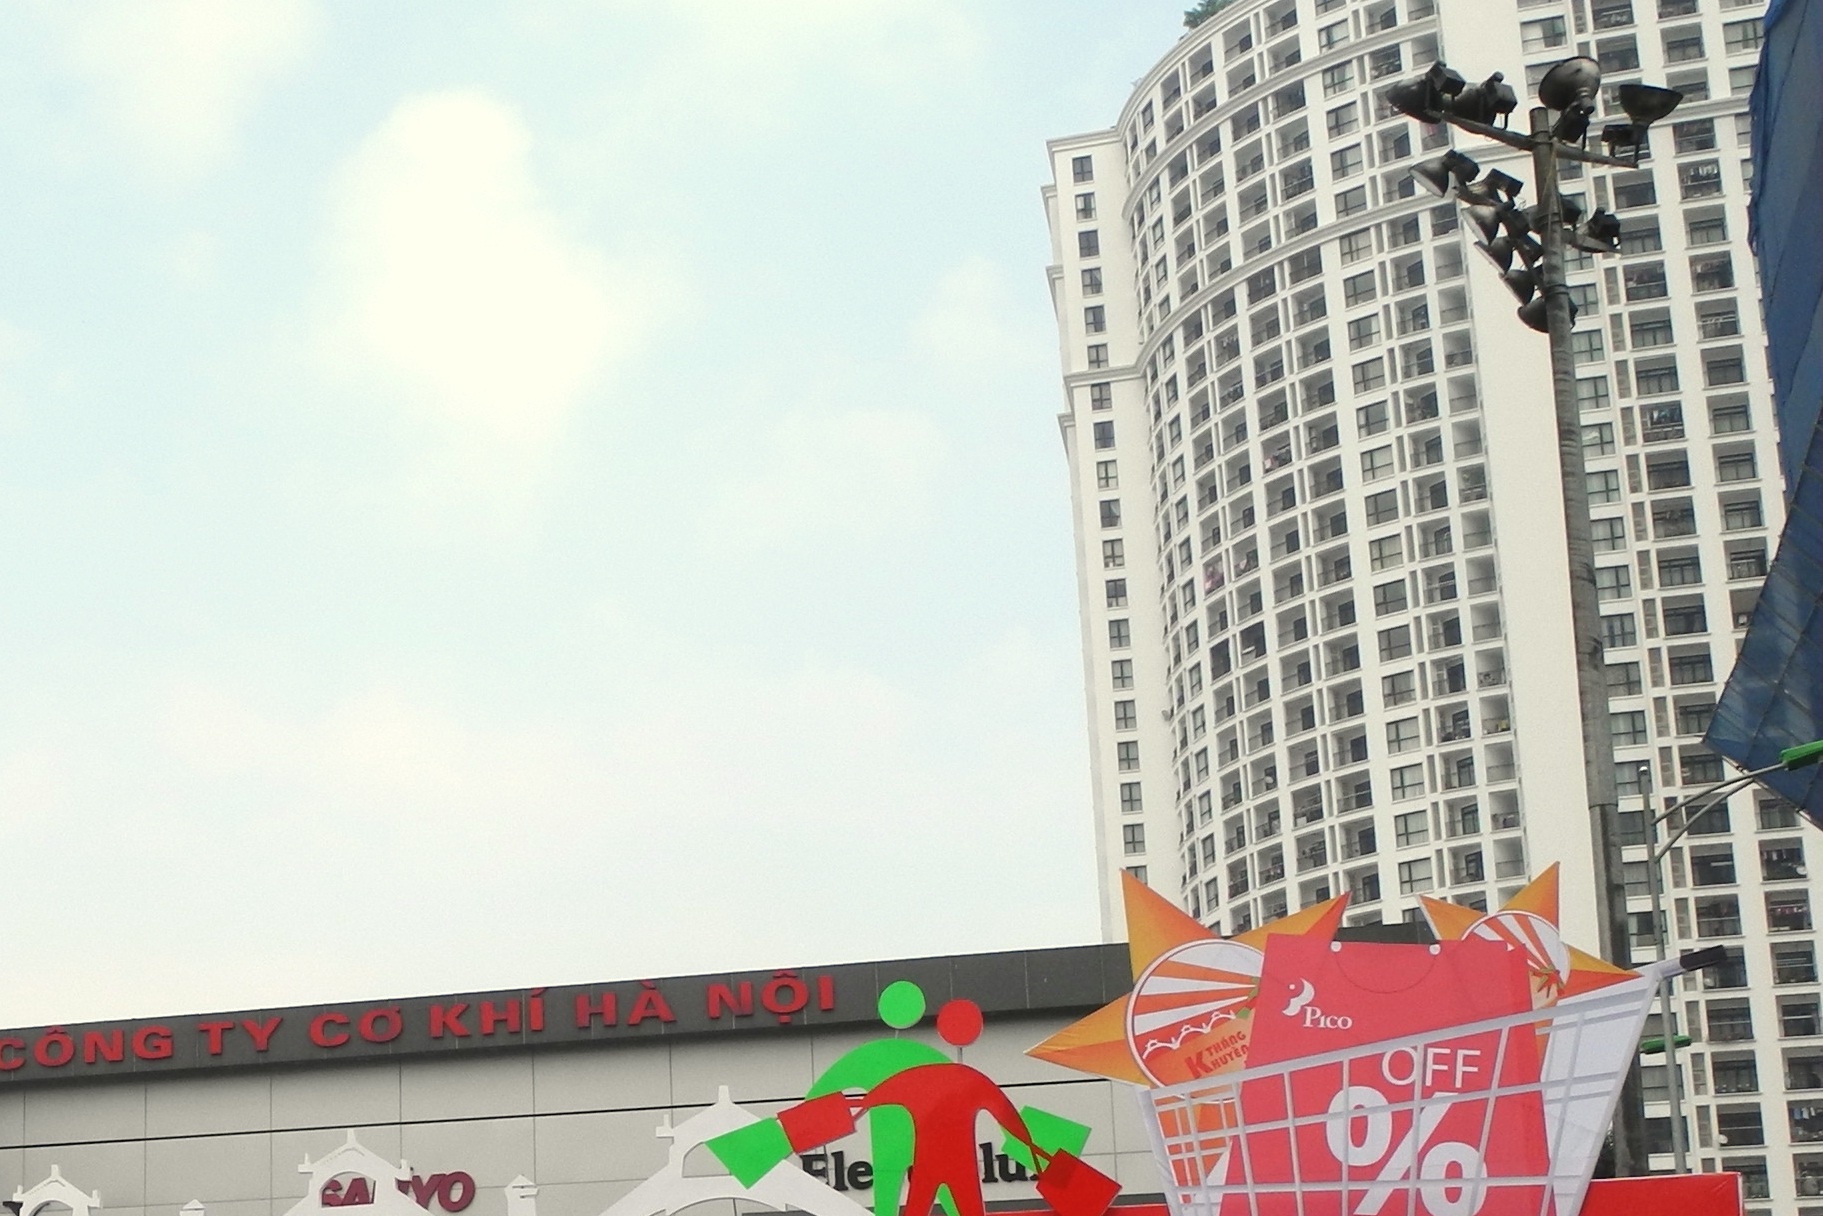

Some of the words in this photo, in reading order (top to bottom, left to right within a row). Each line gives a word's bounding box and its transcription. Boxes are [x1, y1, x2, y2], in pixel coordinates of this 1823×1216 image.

[199, 1017, 284, 1056] TY
[309, 1006, 404, 1048] CƠ
[429, 987, 546, 1039] KHÍ
[577, 979, 675, 1027] HÀ
[707, 971, 837, 1024] NỘI
[1302, 1005, 1353, 1031] Pico
[1382, 1047, 1482, 1088] OFF
[322, 1171, 476, 1213] SAYO
